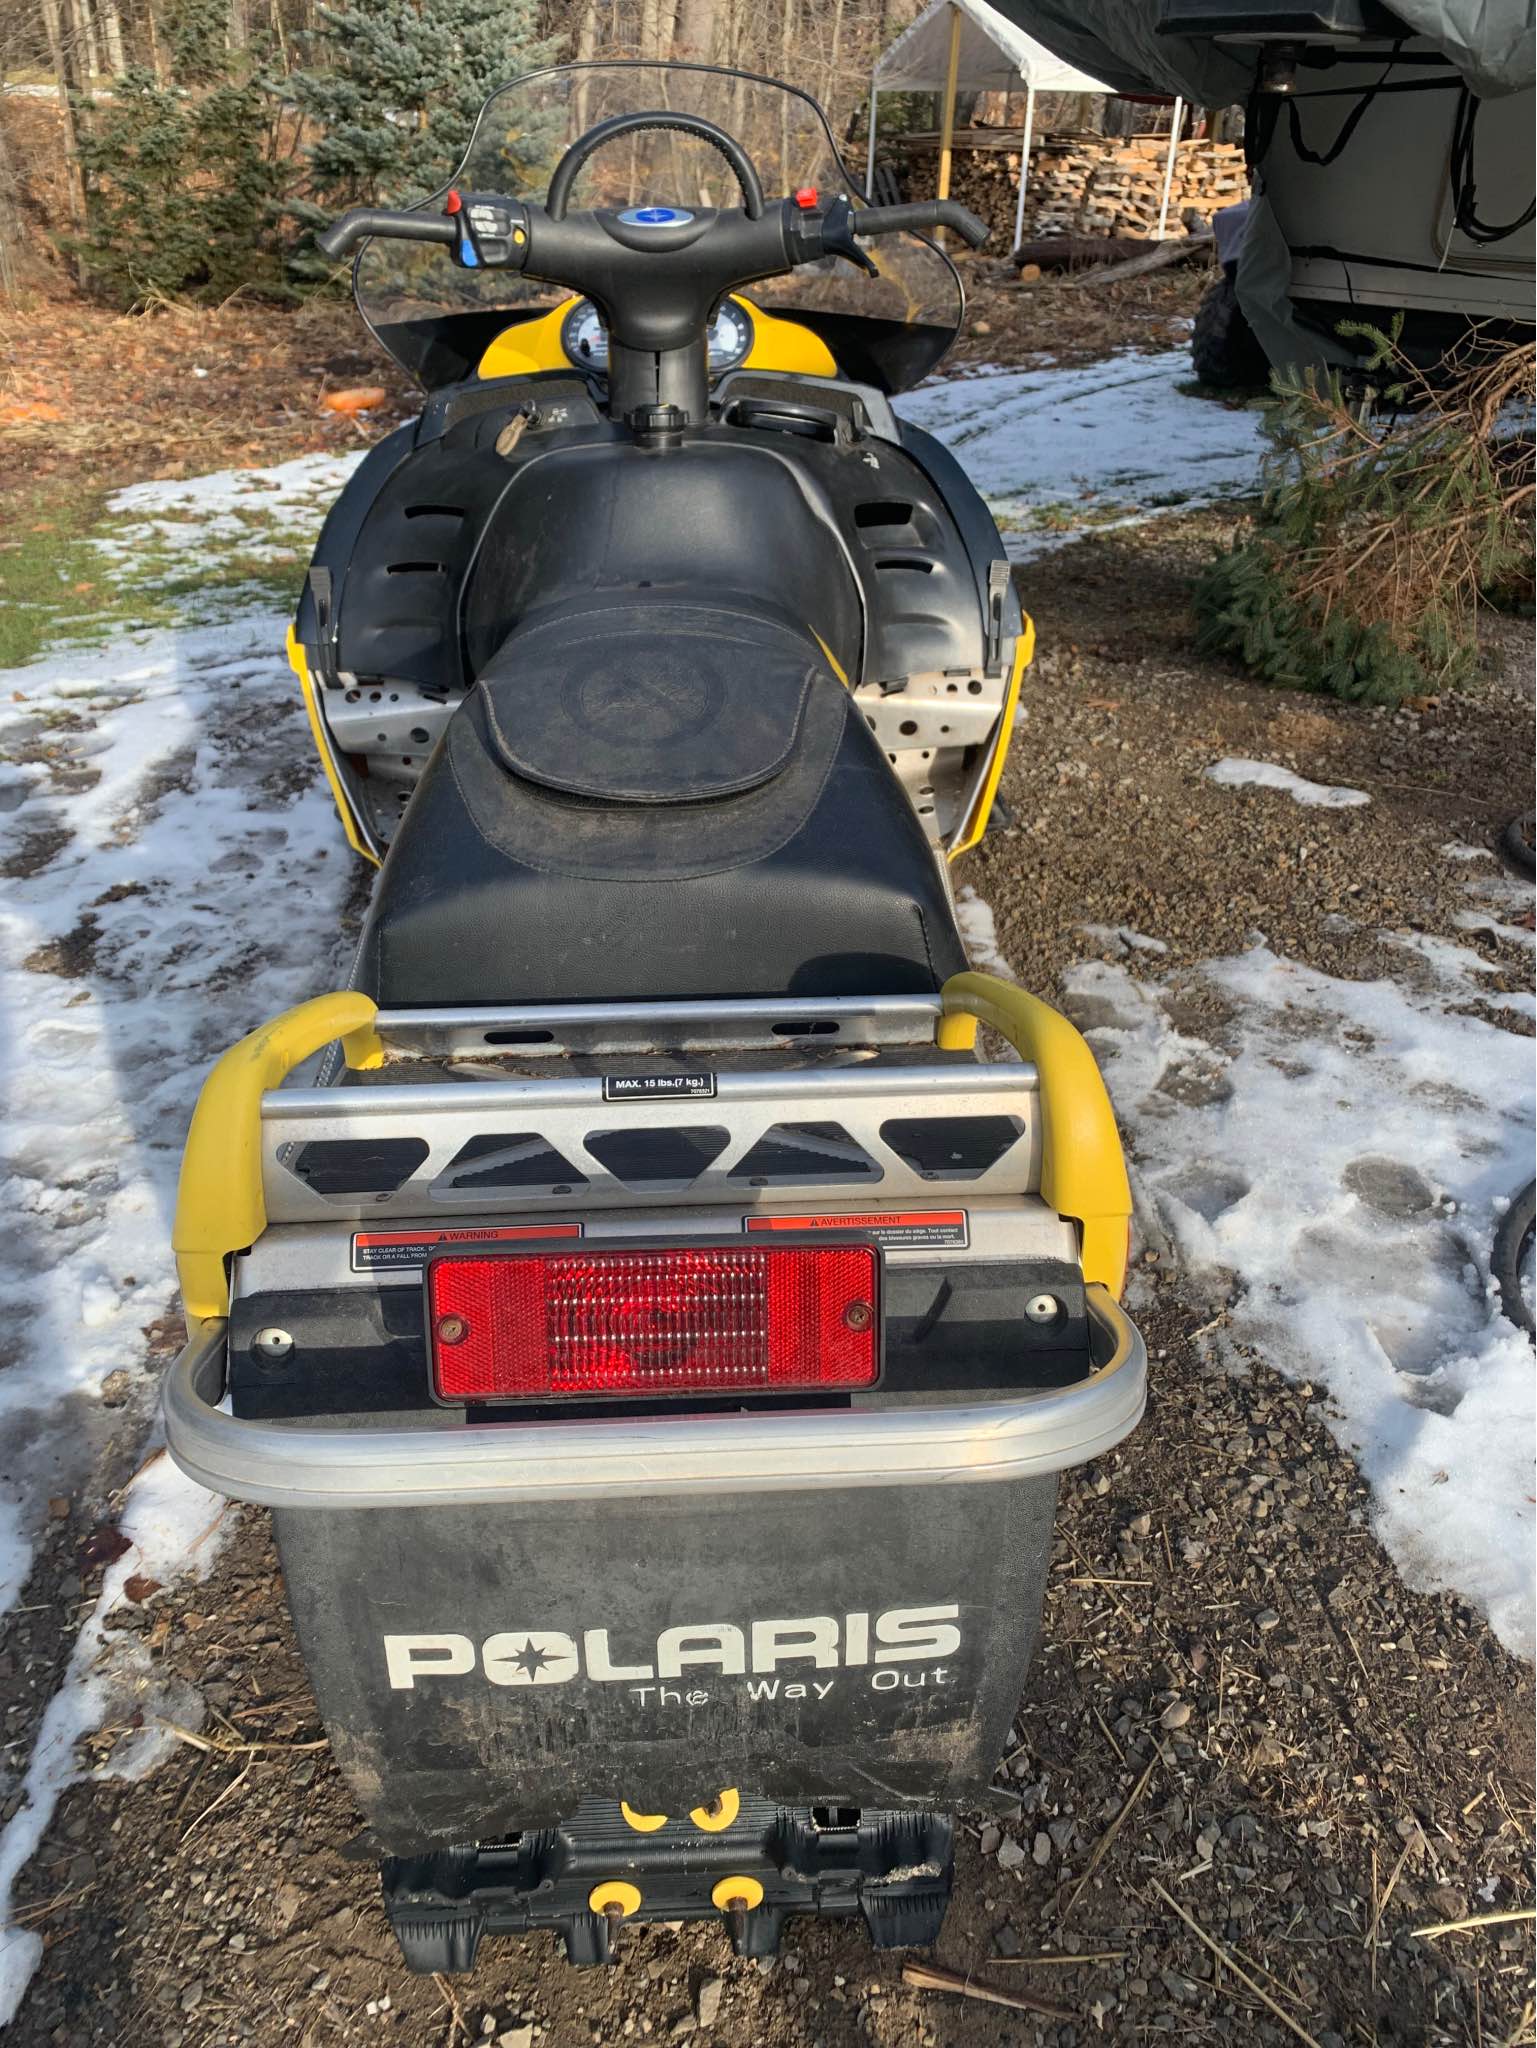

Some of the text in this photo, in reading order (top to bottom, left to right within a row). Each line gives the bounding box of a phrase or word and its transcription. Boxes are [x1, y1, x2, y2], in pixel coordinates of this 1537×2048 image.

[615, 1079, 642, 1089] MAX.
[644, 1079, 656, 1087] 15
[686, 1077, 704, 1088] kg.)
[821, 1216, 901, 1226] AVERTISSEMENT
[449, 1231, 498, 1241] WARNING
[383, 1604, 961, 1690] POLARIS
[631, 1665, 947, 1708] The Way Out
